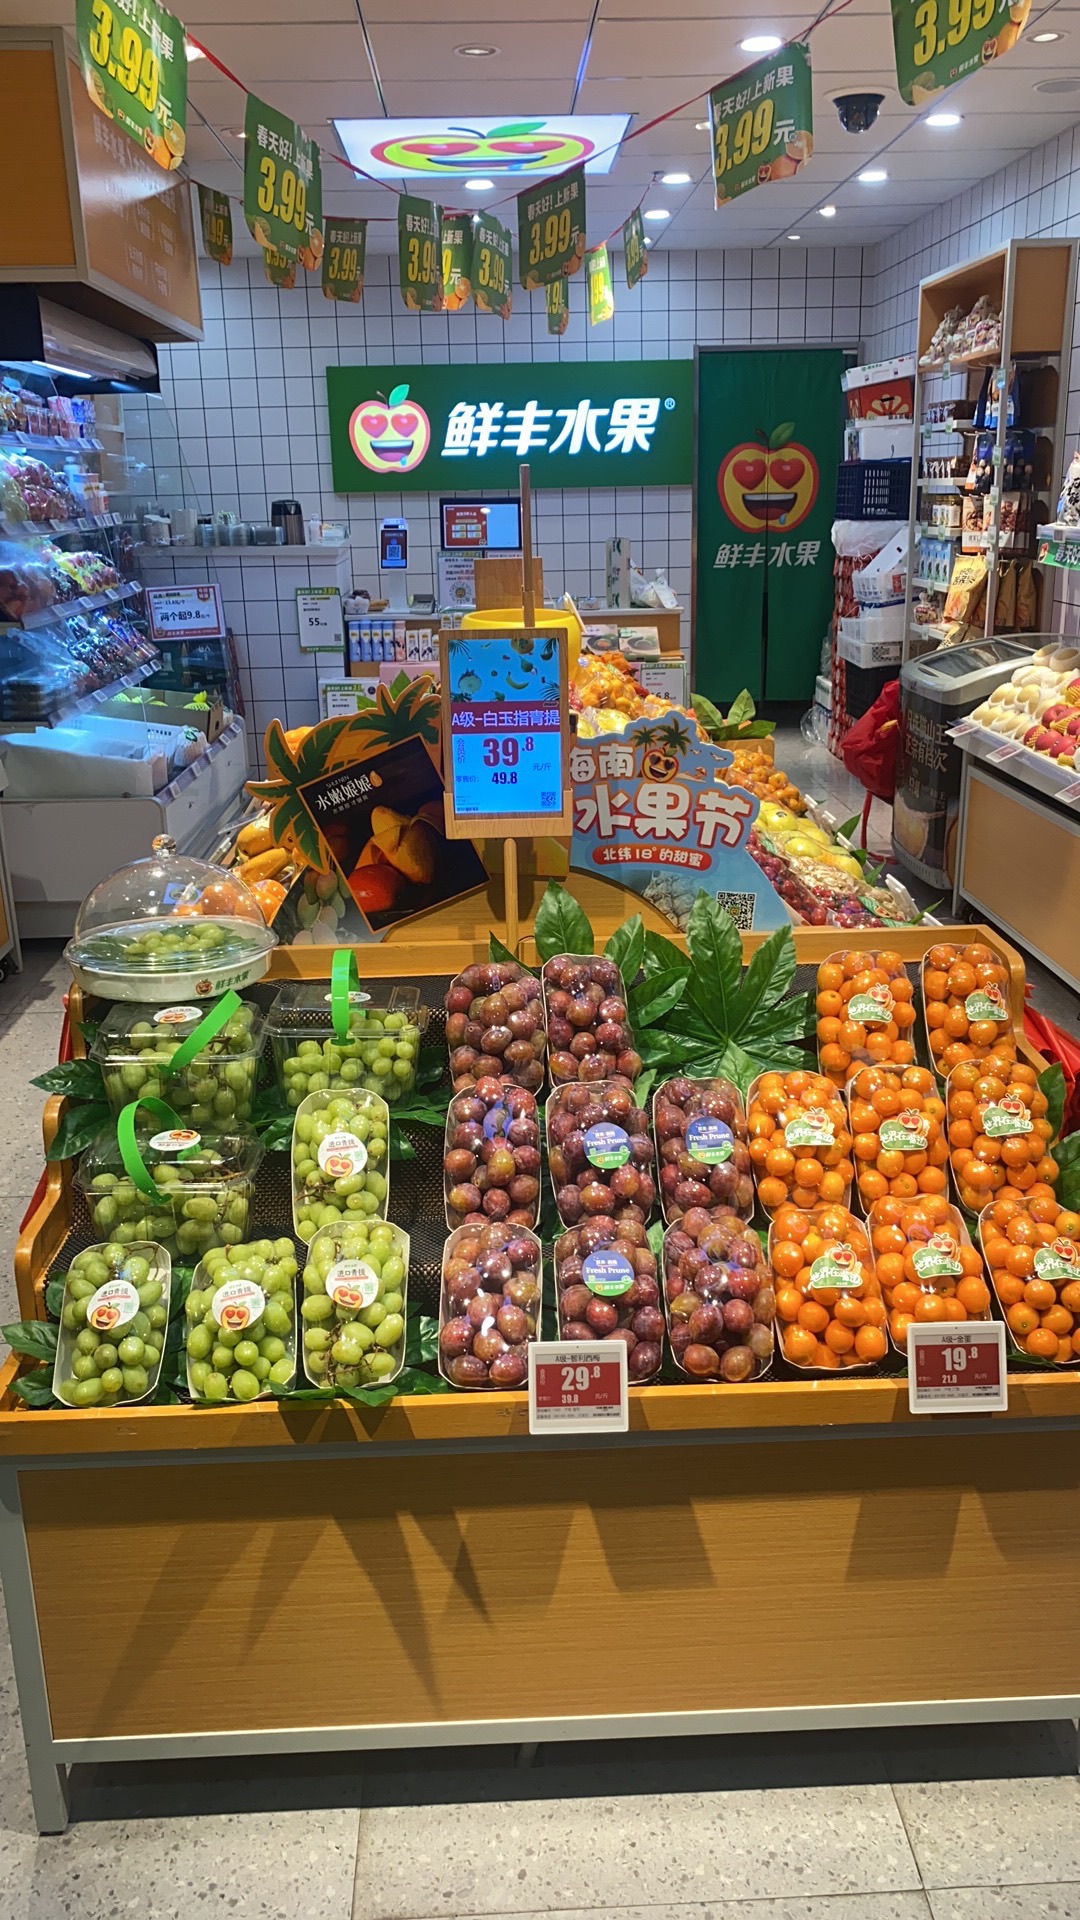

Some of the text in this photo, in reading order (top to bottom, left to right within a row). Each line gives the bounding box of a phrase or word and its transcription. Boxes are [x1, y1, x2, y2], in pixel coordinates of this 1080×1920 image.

[440, 397, 661, 457] 鲜丰水果
[713, 540, 821, 569] 鲜丰水果
[451, 710, 561, 728] A级-白玉指青提
[532, 763, 552, 771] 元/斤
[570, 743, 634, 784] 海南
[491, 771, 518, 785] 49.8
[575, 783, 751, 846] 水果节
[603, 847, 704, 868] 北纬18°的甜蜜
[586, 1139, 606, 1147] Fresh
[689, 1133, 708, 1141] Fresh
[941, 1346, 979, 1371] 19.8
[561, 1366, 601, 1391] 29.8
[941, 1375, 958, 1384] 21.8
[561, 1394, 579, 1404] 39.8
